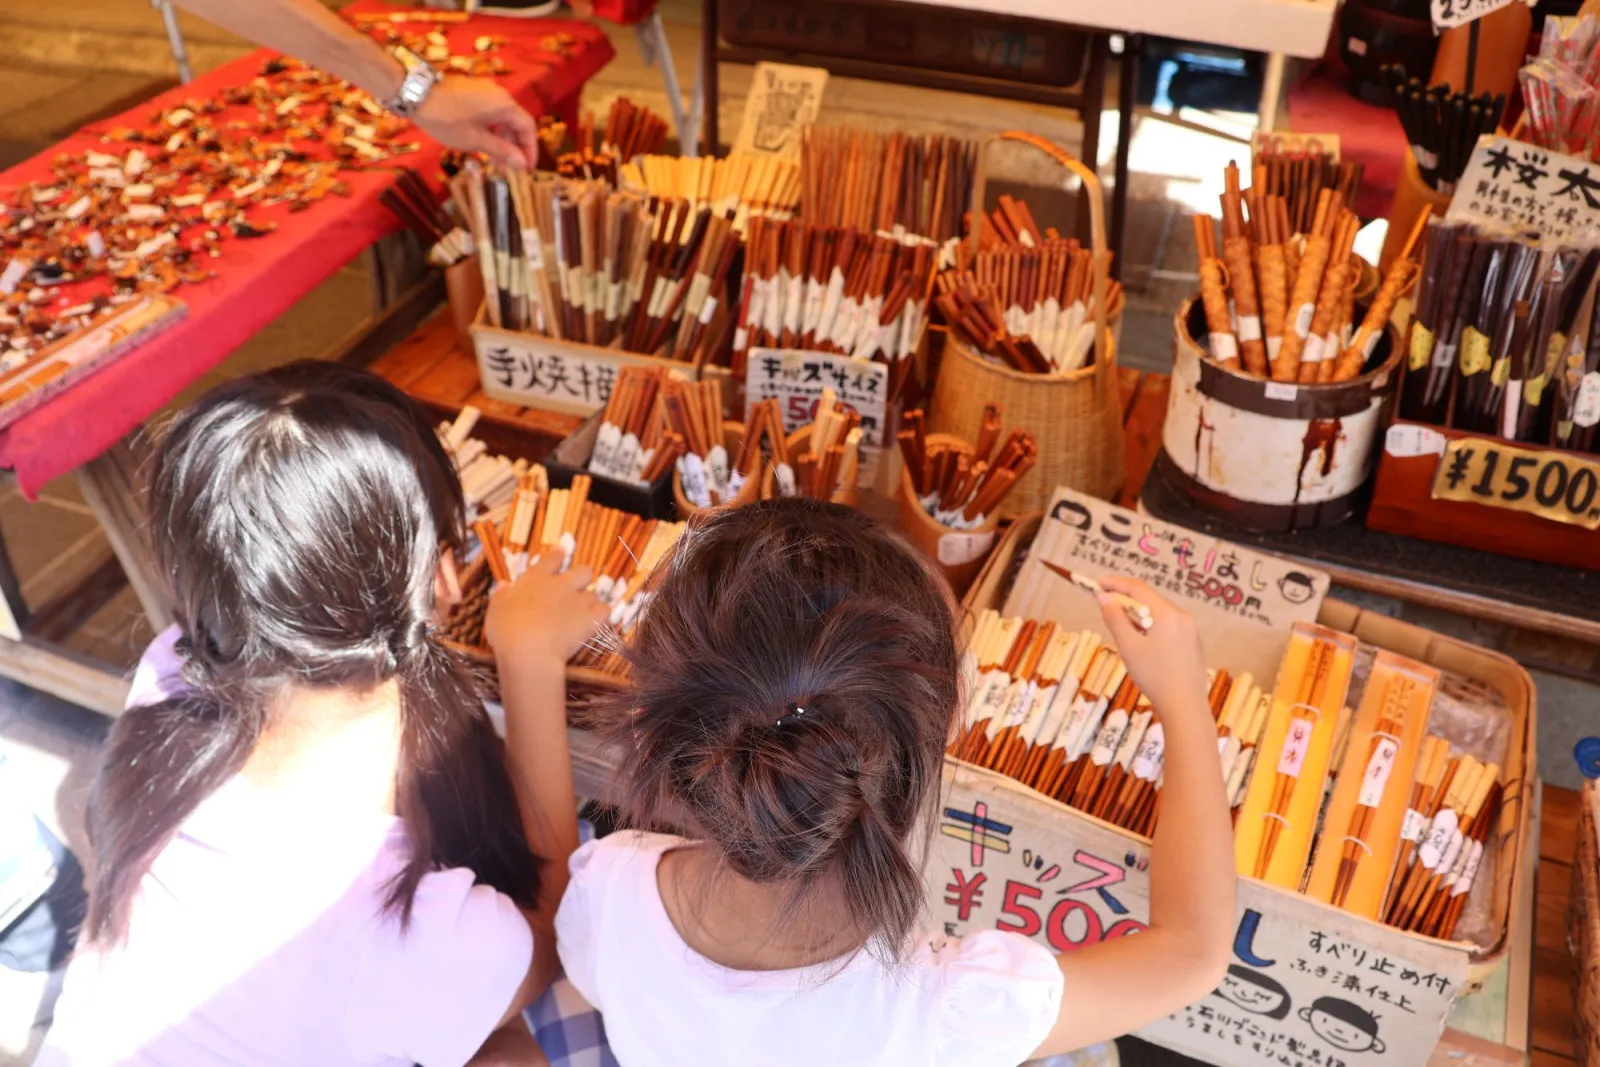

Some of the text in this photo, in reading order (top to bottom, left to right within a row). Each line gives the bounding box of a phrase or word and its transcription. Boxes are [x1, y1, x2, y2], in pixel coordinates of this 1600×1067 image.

[941, 801, 1277, 969] キッズ し
[1308, 930, 1452, 996] すべり止め付
